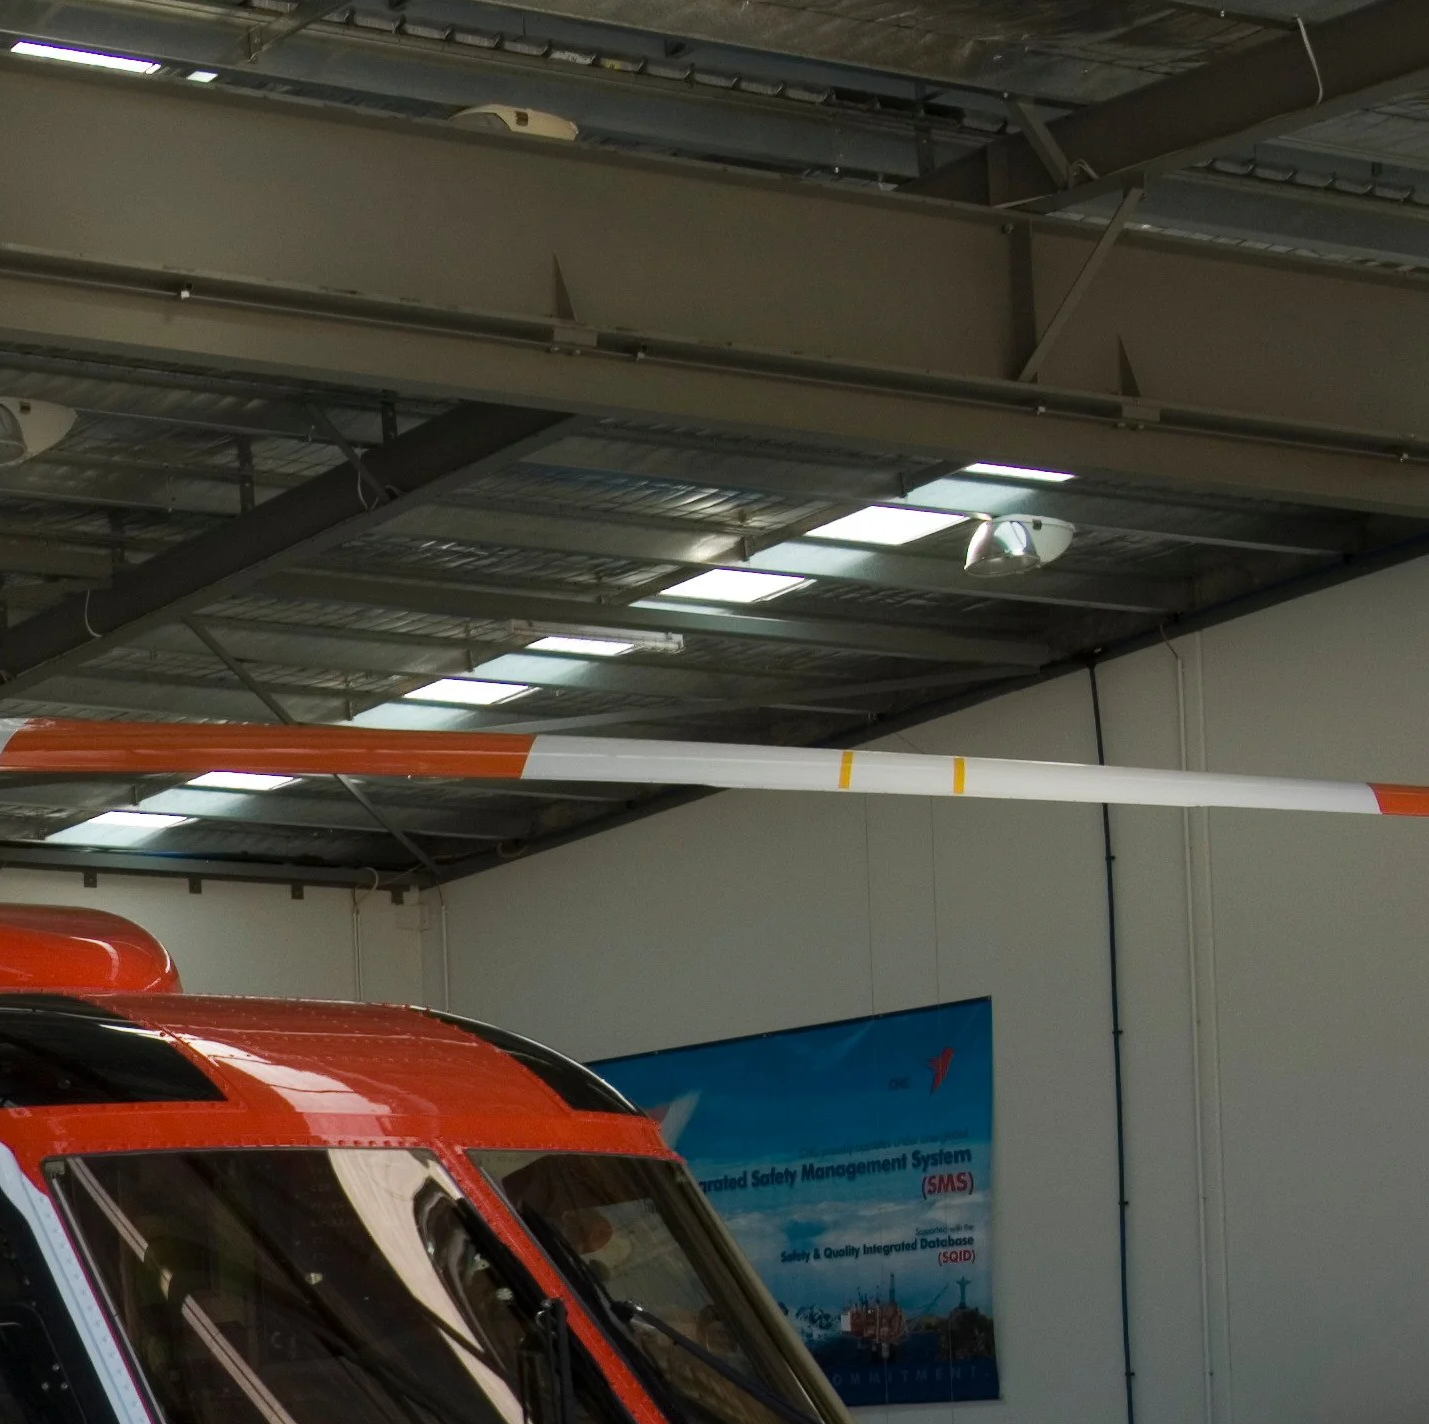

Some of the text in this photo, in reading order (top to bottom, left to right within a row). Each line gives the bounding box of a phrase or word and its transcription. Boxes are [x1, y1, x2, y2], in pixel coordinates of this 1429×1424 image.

[752, 1166, 797, 1189] Safety
[801, 1154, 908, 1181] Management
[912, 1146, 972, 1171] System
[921, 1171, 975, 1200] (SMS)
[780, 1235, 974, 1263] Safety & Quality Integrated Database
[938, 1249, 976, 1266] (SQID)
